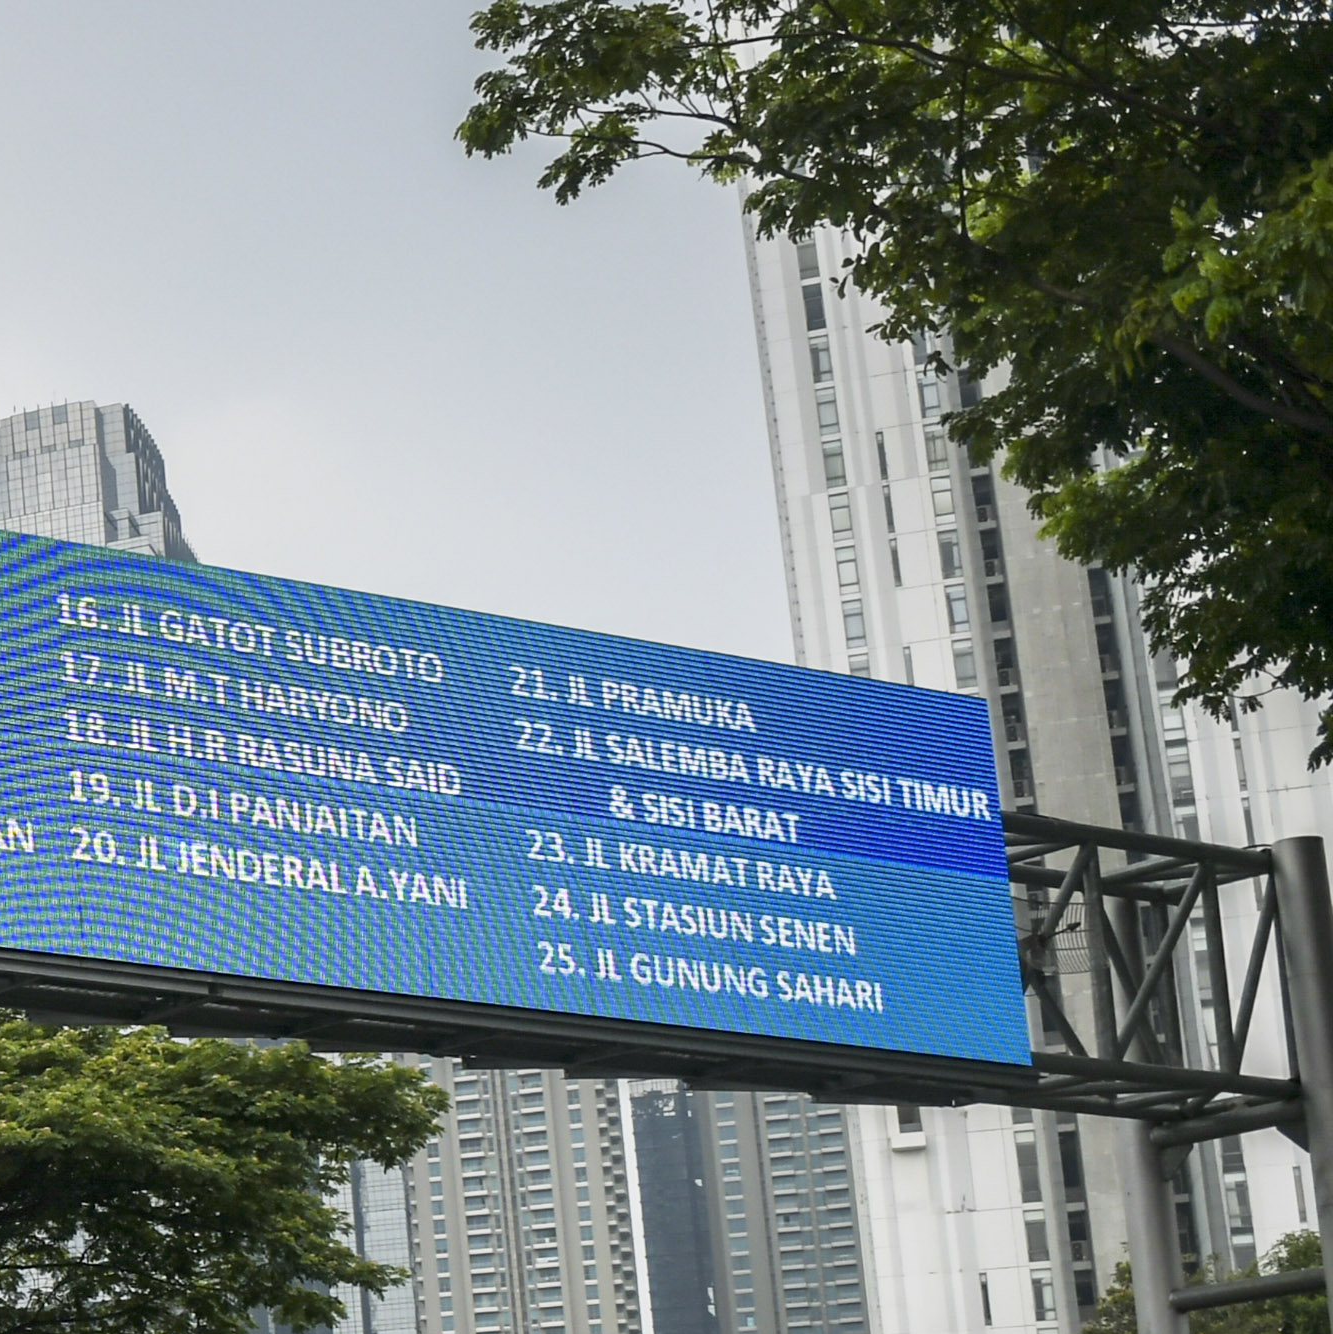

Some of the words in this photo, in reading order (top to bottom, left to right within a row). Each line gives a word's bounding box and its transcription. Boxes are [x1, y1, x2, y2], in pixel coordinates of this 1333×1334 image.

[118, 602, 149, 638] JL
[159, 609, 277, 659] GATOT
[285, 630, 444, 684] SUBROTO
[122, 661, 154, 695] JL
[164, 666, 230, 706] M.T
[239, 679, 410, 733] HARYONO
[509, 666, 557, 702] 21.
[565, 676, 592, 709] JL
[601, 681, 757, 733] PRAMUKA
[128, 717, 160, 753] JL
[167, 723, 229, 762] H.R
[237, 736, 379, 786] RASUNA
[385, 756, 461, 796] SAID
[513, 719, 563, 757] 22.
[572, 730, 601, 763] JL
[605, 735, 751, 784] SALEMBA
[756, 755, 836, 798] RAYA
[840, 771, 893, 806] SISI
[896, 778, 992, 822] TIMUR
[69, 770, 121, 807] 19.
[130, 779, 162, 814] JL
[231, 794, 419, 848] PANJAITAN
[608, 785, 634, 819] &
[642, 793, 696, 827] SISI
[701, 801, 801, 844] BARAT
[69, 826, 125, 867] 20.
[135, 835, 167, 873] JL
[176, 841, 349, 895] JENDERAL
[524, 829, 573, 865] 23.
[583, 837, 611, 870] JL
[618, 841, 752, 888] KRAMAT
[756, 861, 837, 901] RAYA
[532, 884, 580, 921] 24.
[589, 893, 618, 927] JL
[624, 896, 755, 943] STASIUN
[759, 915, 857, 956] SENEN
[537, 941, 585, 977] 25.
[593, 947, 622, 982] JL
[629, 952, 768, 999] GUNUNG
[776, 970, 884, 1014] SAHARI
